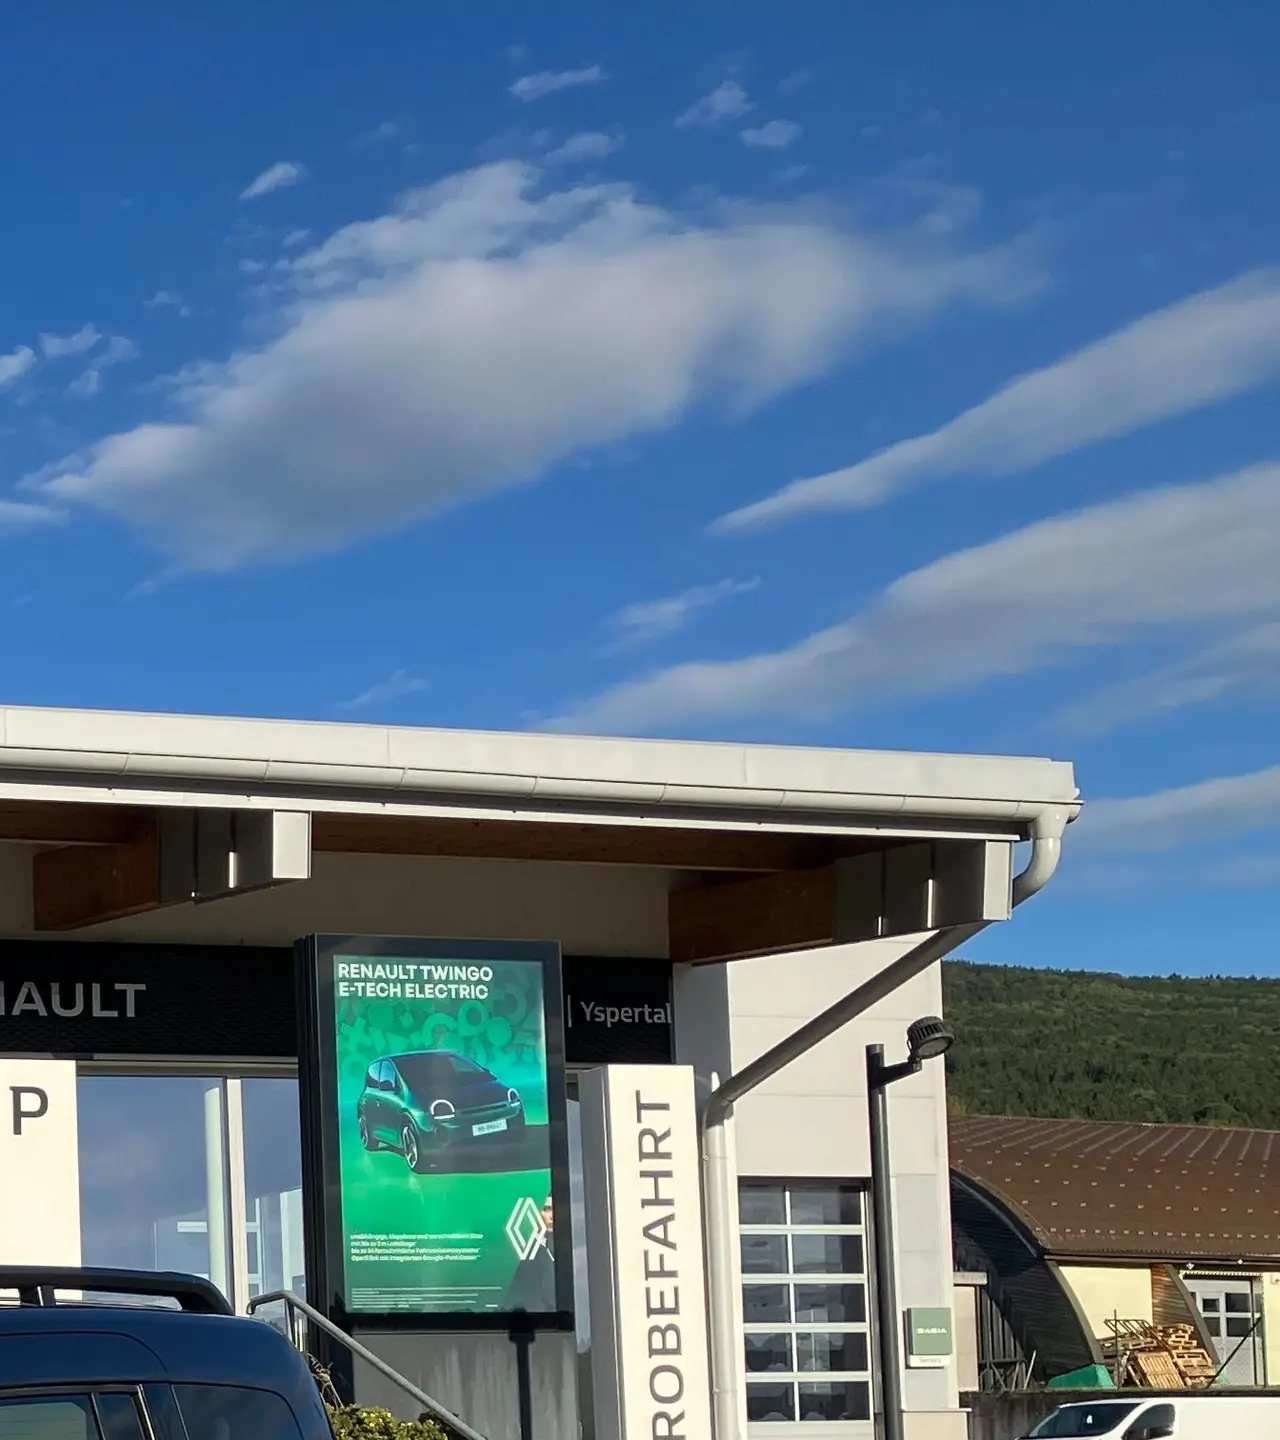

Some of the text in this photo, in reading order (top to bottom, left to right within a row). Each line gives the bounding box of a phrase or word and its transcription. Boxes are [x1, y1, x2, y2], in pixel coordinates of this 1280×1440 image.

[338, 963, 493, 982] RENAULT TWINGO
[339, 981, 489, 1000] E-TECH ELECTRIC
[579, 1001, 673, 1028] Yspertal
[8, 1085, 49, 1136] P
